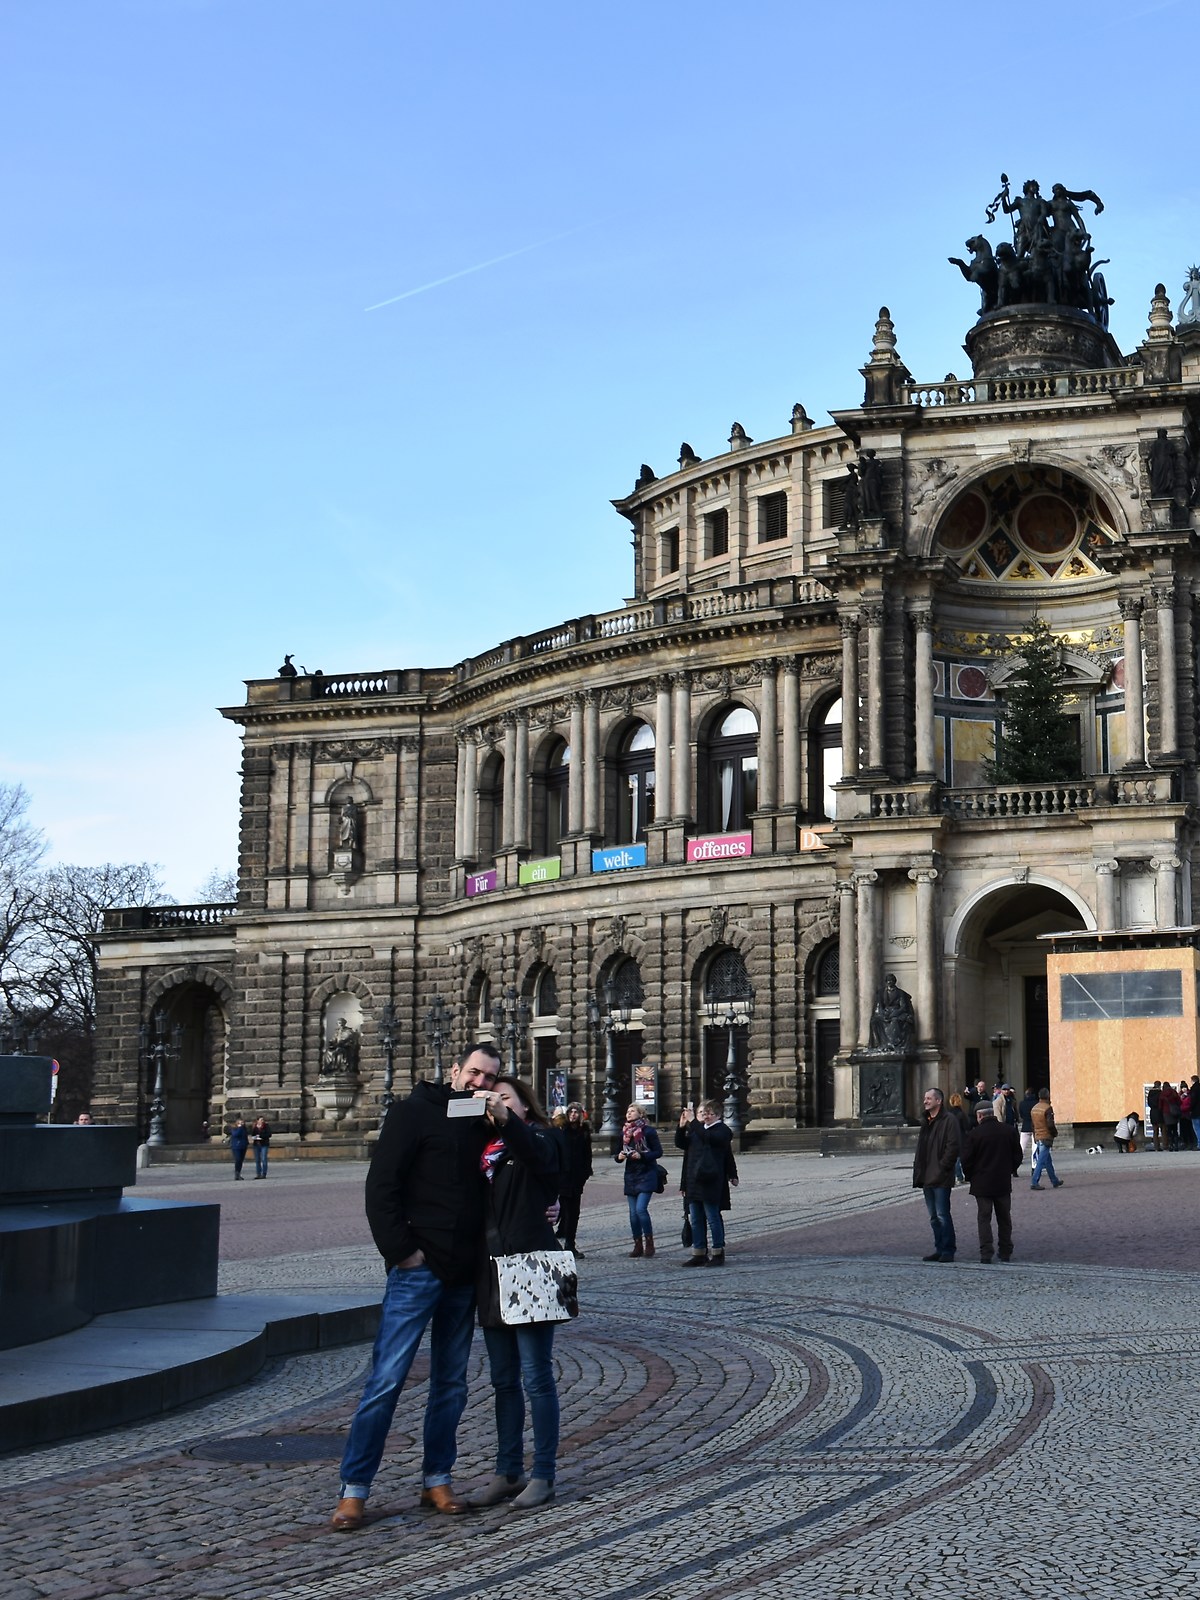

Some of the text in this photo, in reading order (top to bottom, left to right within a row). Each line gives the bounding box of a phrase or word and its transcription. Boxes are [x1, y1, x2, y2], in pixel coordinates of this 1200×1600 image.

[693, 840, 746, 859] offenes
[604, 852, 633, 868] welt-
[532, 864, 546, 881] ein
[475, 876, 488, 893] Für
